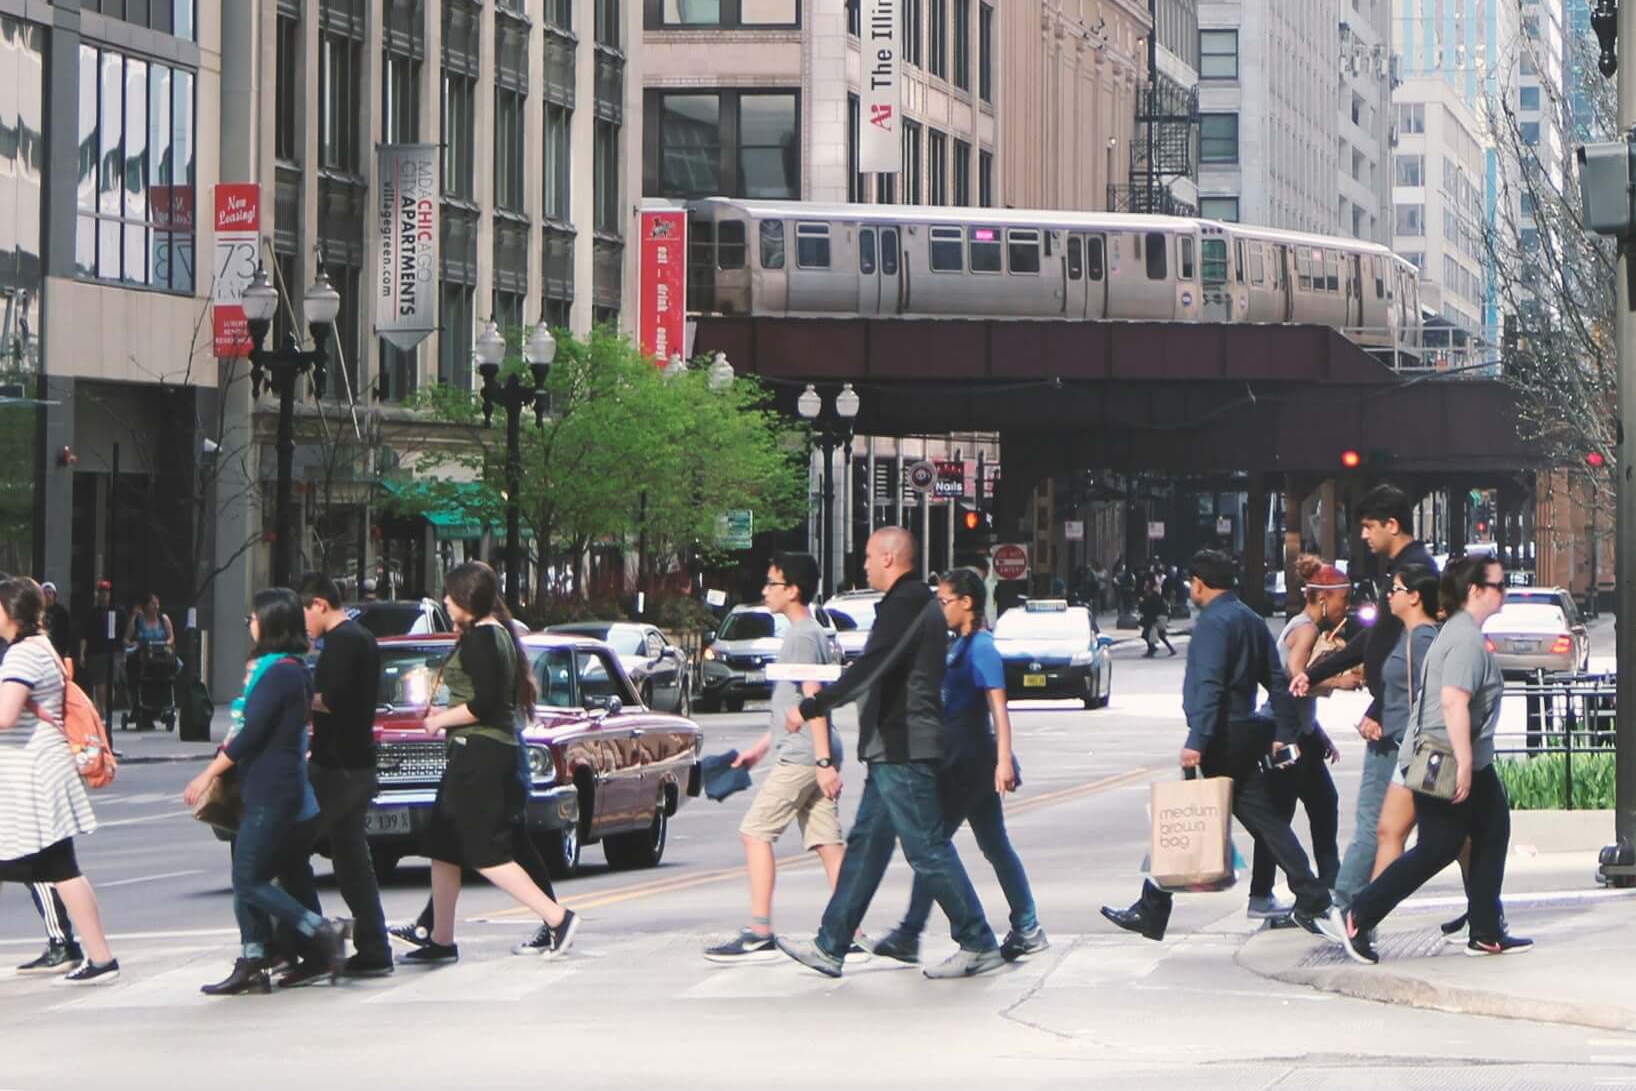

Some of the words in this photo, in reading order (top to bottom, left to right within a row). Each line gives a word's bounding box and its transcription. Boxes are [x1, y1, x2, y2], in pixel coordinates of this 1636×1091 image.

[871, 49, 893, 91] The
[217, 204, 256, 225] Leasing!
[380, 181, 395, 297] villagegreen.com
[217, 243, 256, 279] 73
[936, 480, 963, 492] Nails
[1159, 802, 1218, 820] medium
[1159, 820, 1206, 835] brown
[1159, 834, 1190, 850] bag
